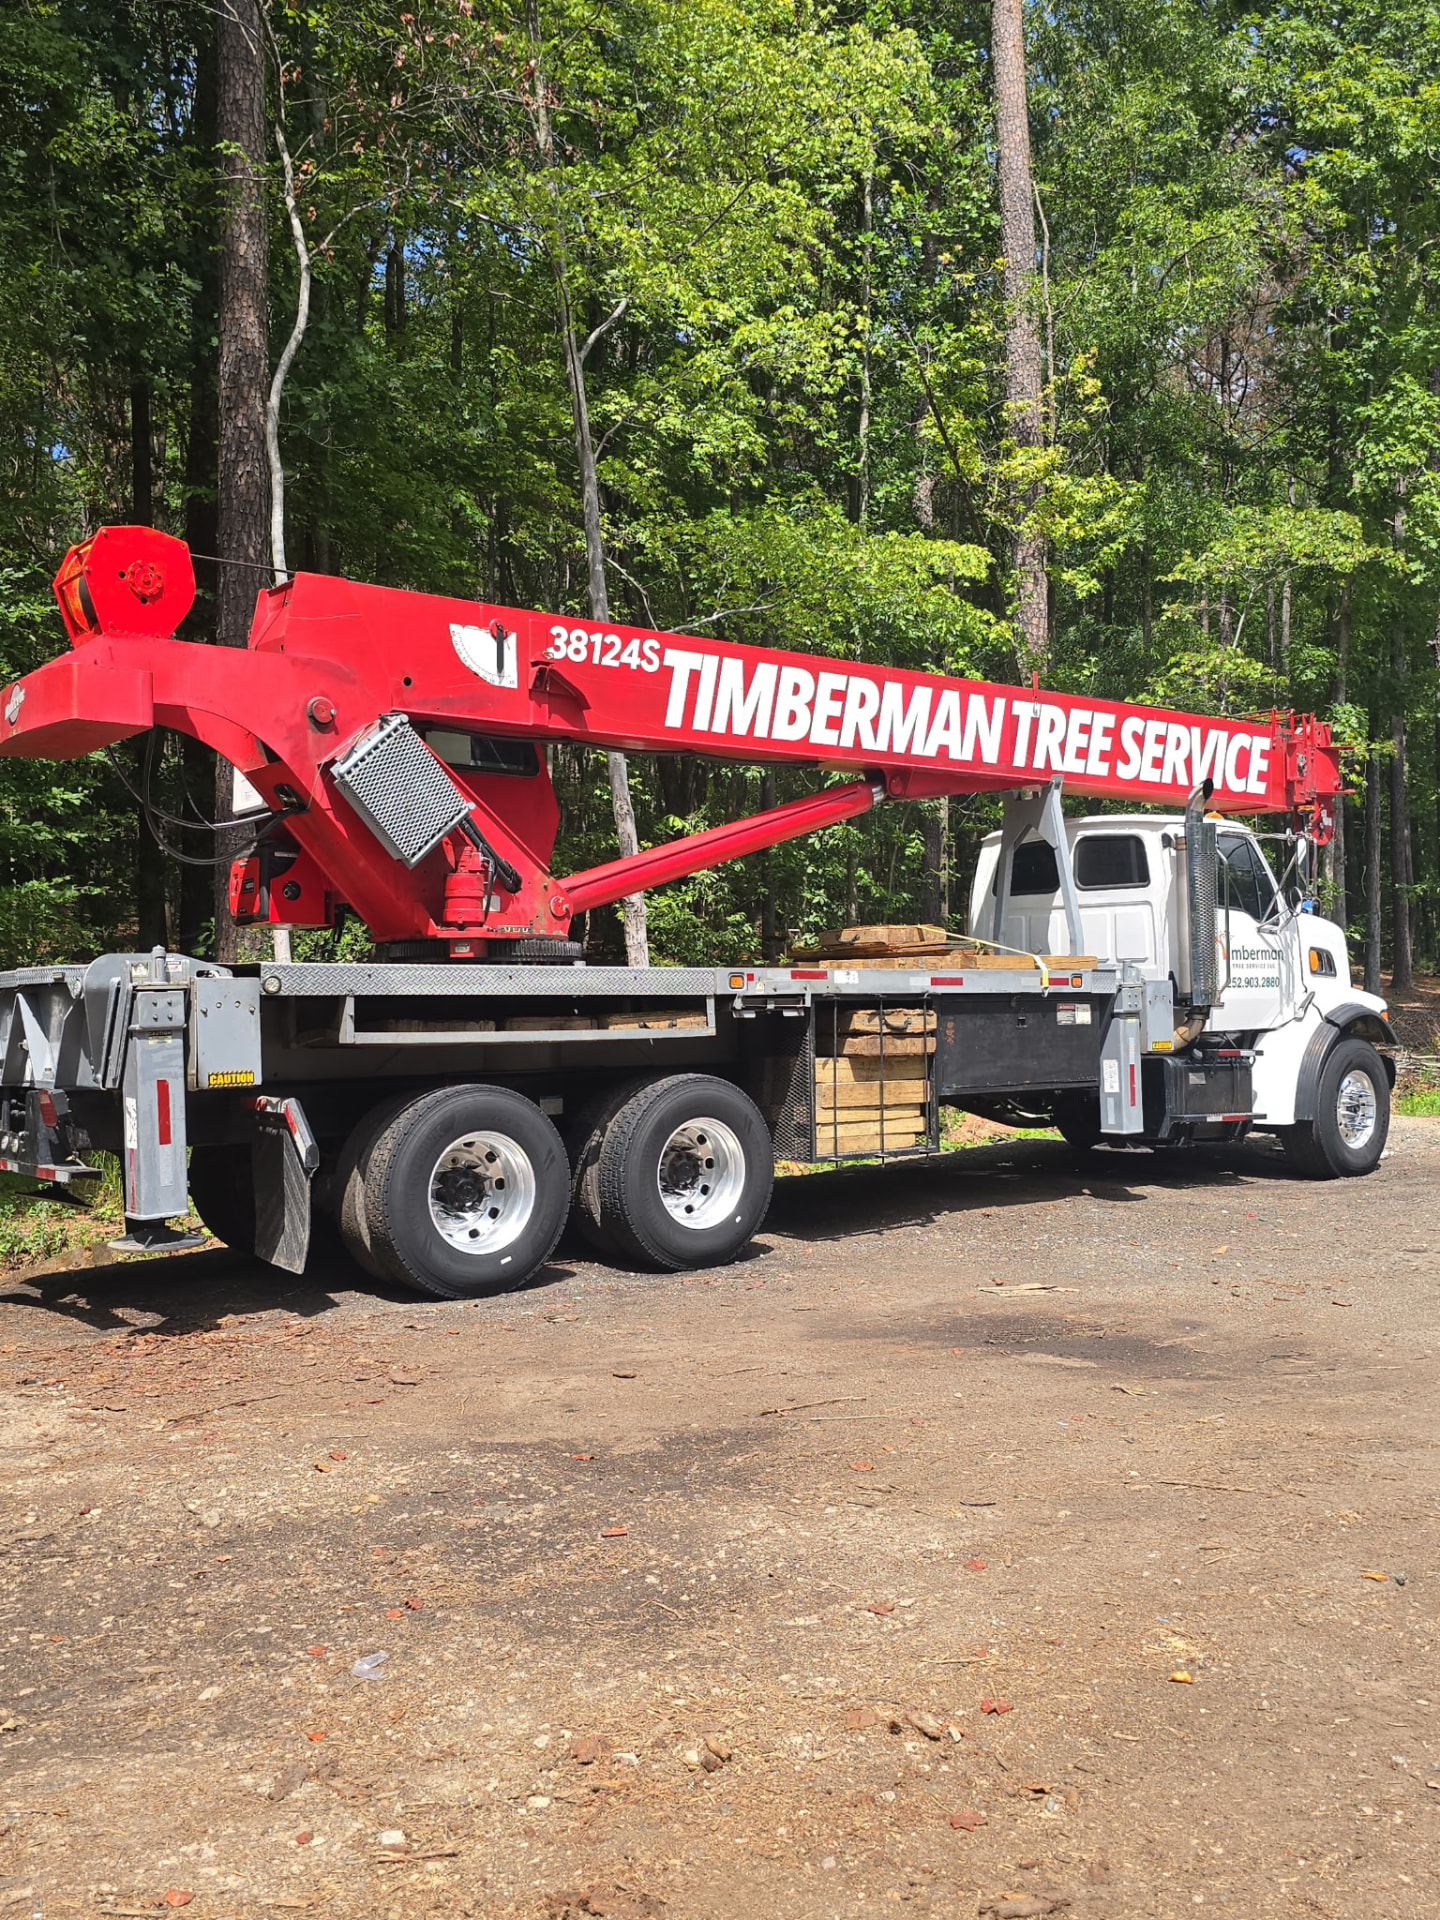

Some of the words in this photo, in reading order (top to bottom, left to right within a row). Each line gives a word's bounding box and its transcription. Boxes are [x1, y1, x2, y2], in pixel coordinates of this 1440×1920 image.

[546, 625, 661, 673] 38124S
[664, 648, 1006, 765] TIMBERMAN
[1011, 700, 1116, 777] TREE
[1116, 716, 1271, 795] SERVICE
[209, 1072, 254, 1085] CAUTION
